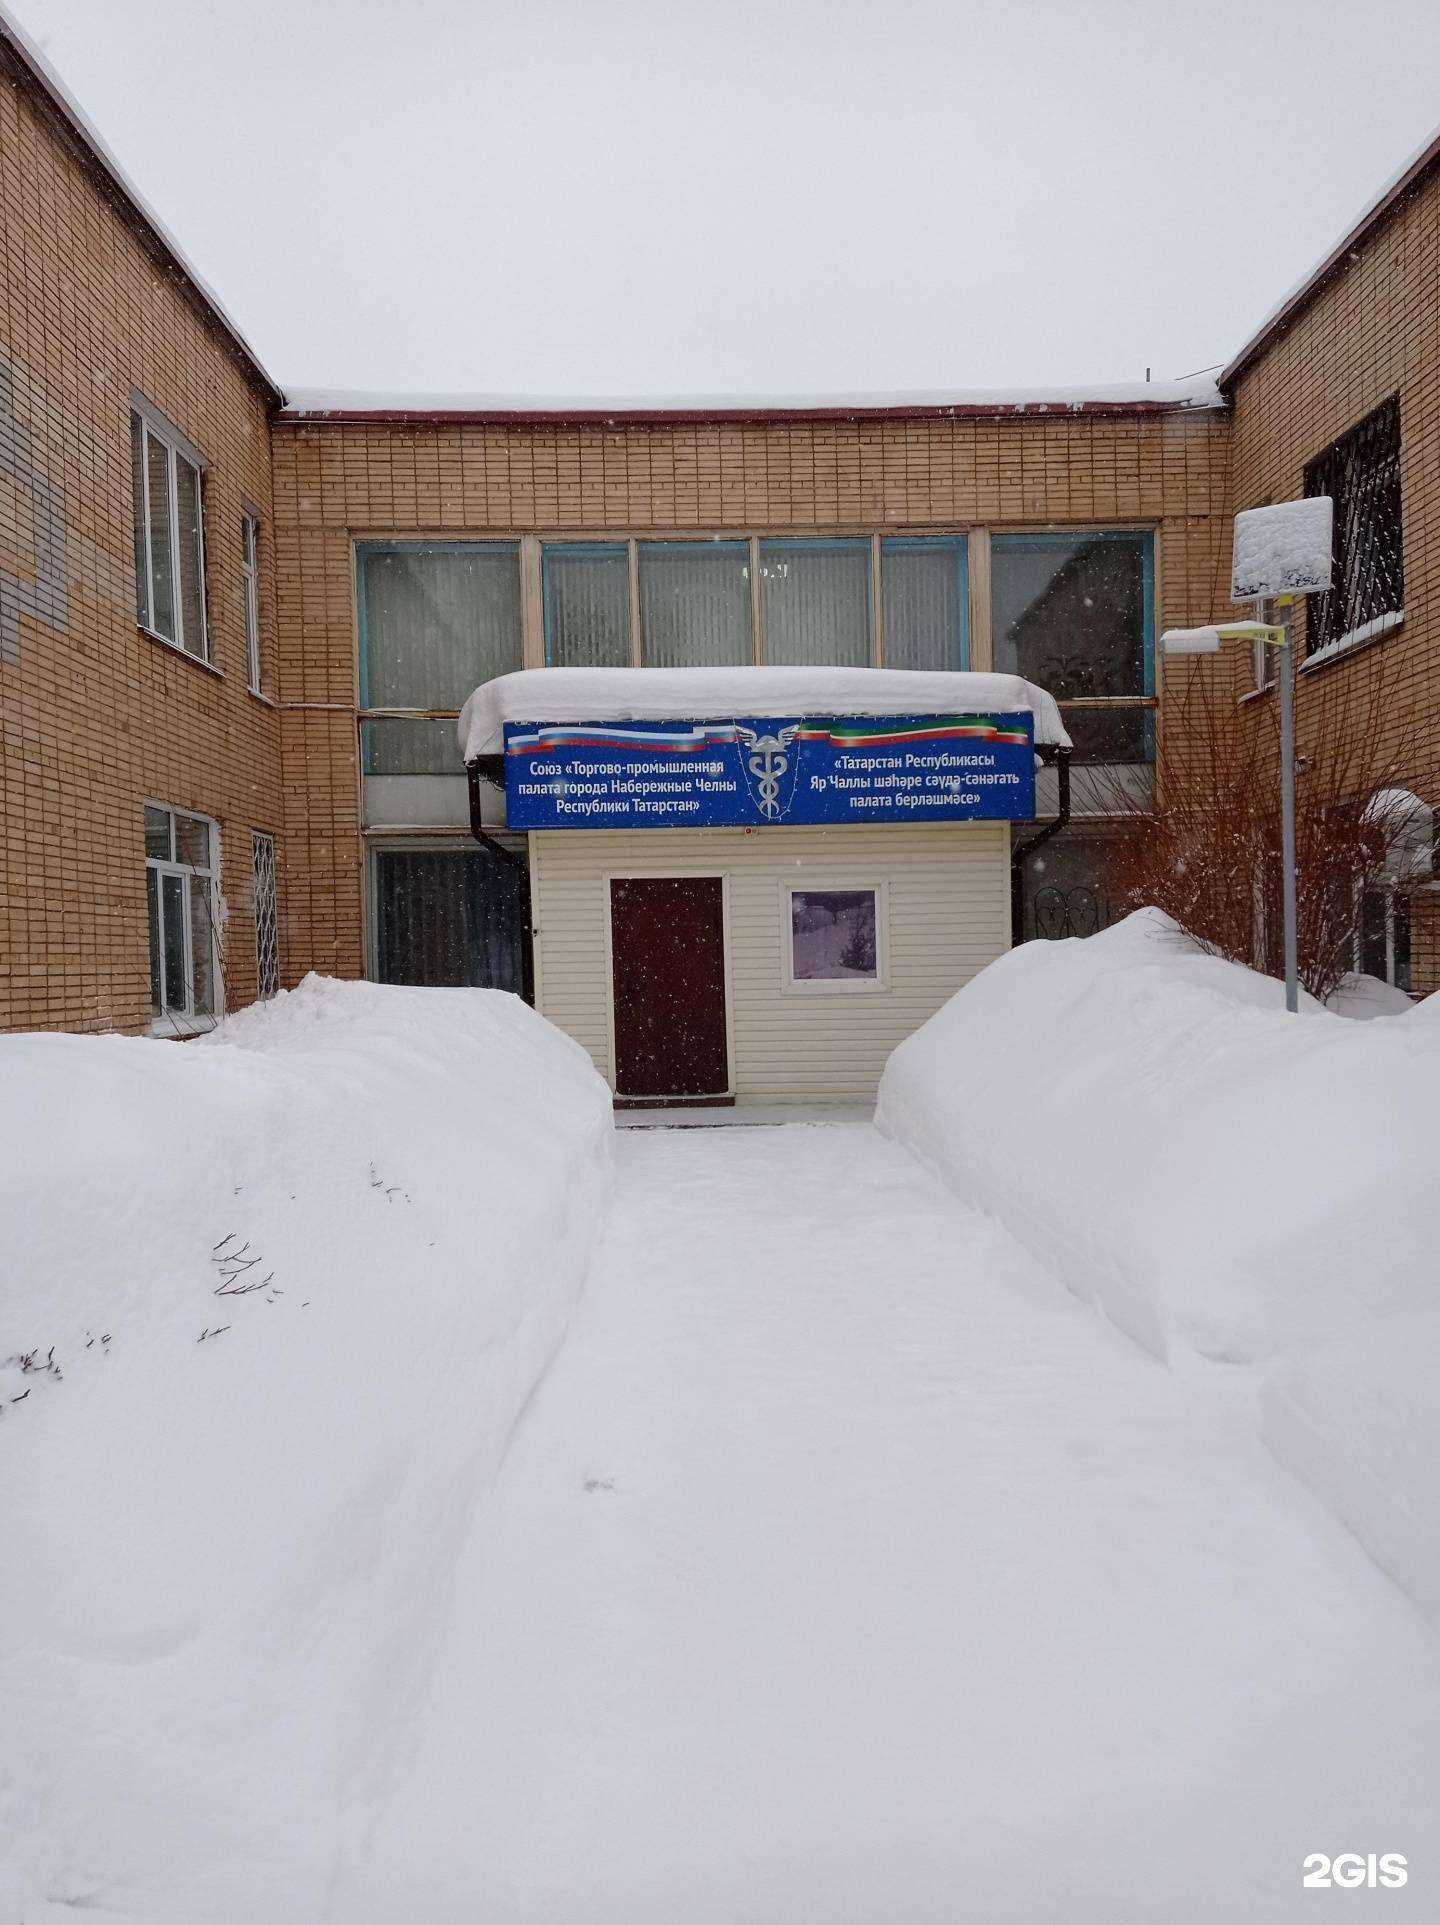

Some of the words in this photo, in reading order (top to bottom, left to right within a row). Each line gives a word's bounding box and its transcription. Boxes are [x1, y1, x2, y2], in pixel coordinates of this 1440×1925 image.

[529, 761, 562, 776] Союз
[565, 760, 724, 778] «Торгово-промышленная
[834, 756, 902, 771] «Татарстан
[905, 754, 995, 771] Республикасы
[518, 783, 561, 795] палата
[564, 782, 608, 797] города
[611, 780, 692, 796] Набережные
[695, 778, 737, 793] Челны
[810, 776, 827, 791] Яр
[830, 775, 871, 789] Чаллы
[874, 773, 922, 790] шәһәре
[556, 798, 630, 816] Республики
[632, 797, 700, 814] Татарстан»
[849, 795, 892, 808] палата
[895, 792, 981, 810] берләшмәсе»
